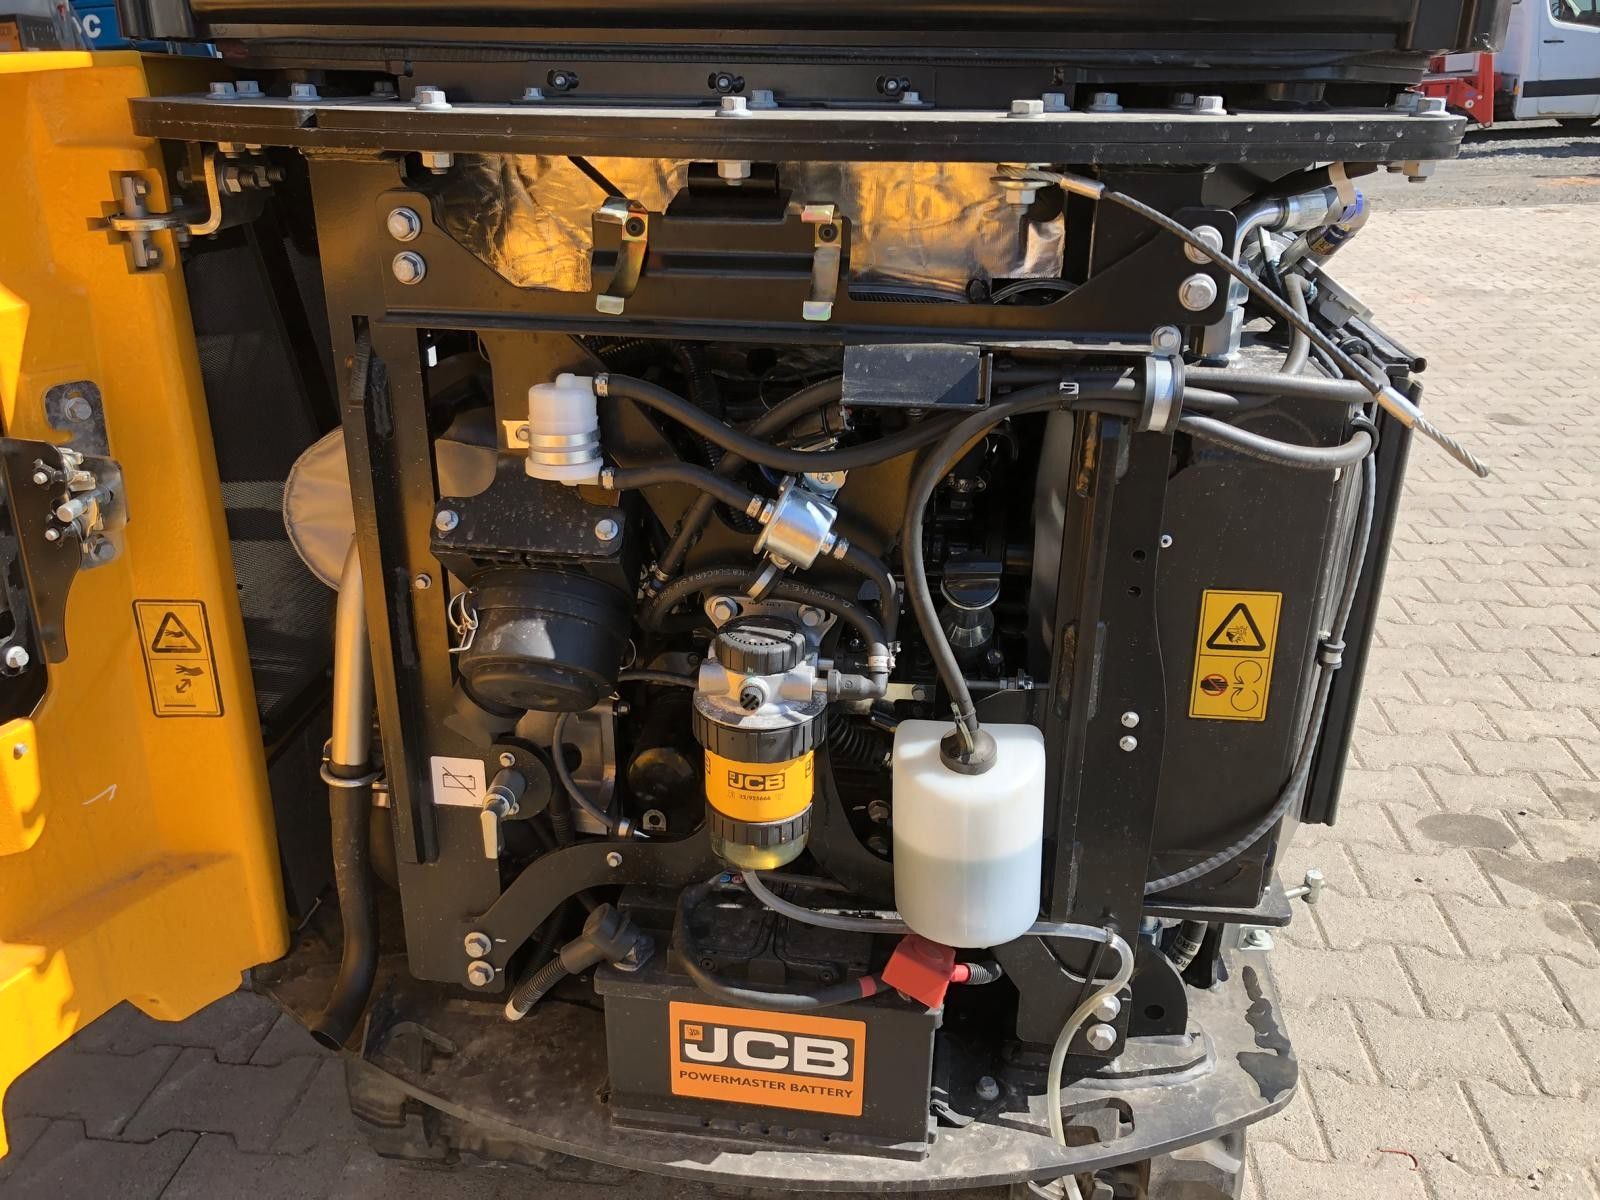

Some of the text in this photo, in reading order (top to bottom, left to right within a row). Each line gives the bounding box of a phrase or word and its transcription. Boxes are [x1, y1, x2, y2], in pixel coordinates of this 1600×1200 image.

[730, 772, 785, 791] JCB
[685, 1027, 849, 1077] JCB
[679, 1070, 853, 1099] POWERMASTER BATTERY
